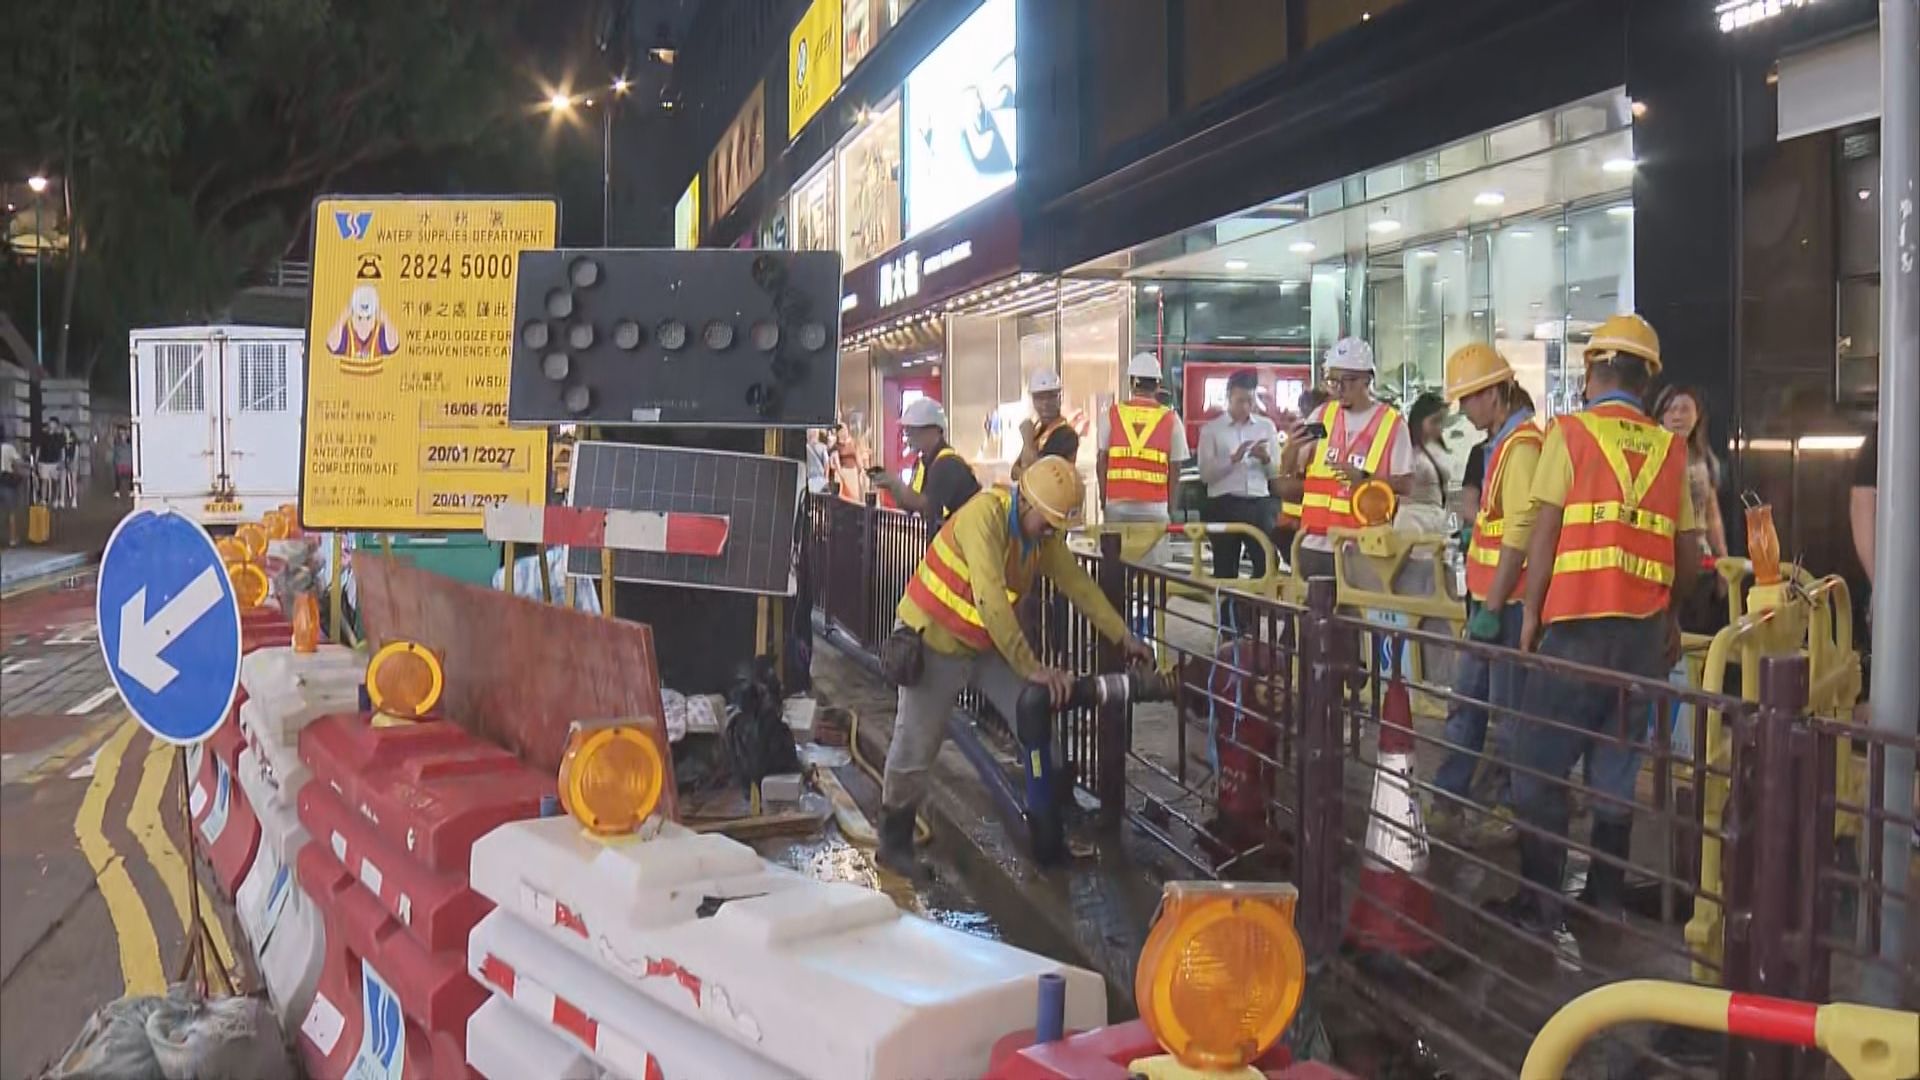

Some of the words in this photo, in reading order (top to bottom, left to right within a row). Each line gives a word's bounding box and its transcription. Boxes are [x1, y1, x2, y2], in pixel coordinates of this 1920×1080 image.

[377, 229, 412, 242] WATER
[418, 230, 467, 243] SUPPLIES
[472, 230, 544, 242] DEPARTMENT
[400, 253, 452, 279] 2824
[460, 253, 512, 279] 5000
[406, 329, 421, 342] WE
[424, 329, 487, 342] APOLOGIZE
[313, 447, 373, 460] ANTICIPATED
[313, 463, 372, 475] COMPLETION
[374, 464, 398, 476] DATE
